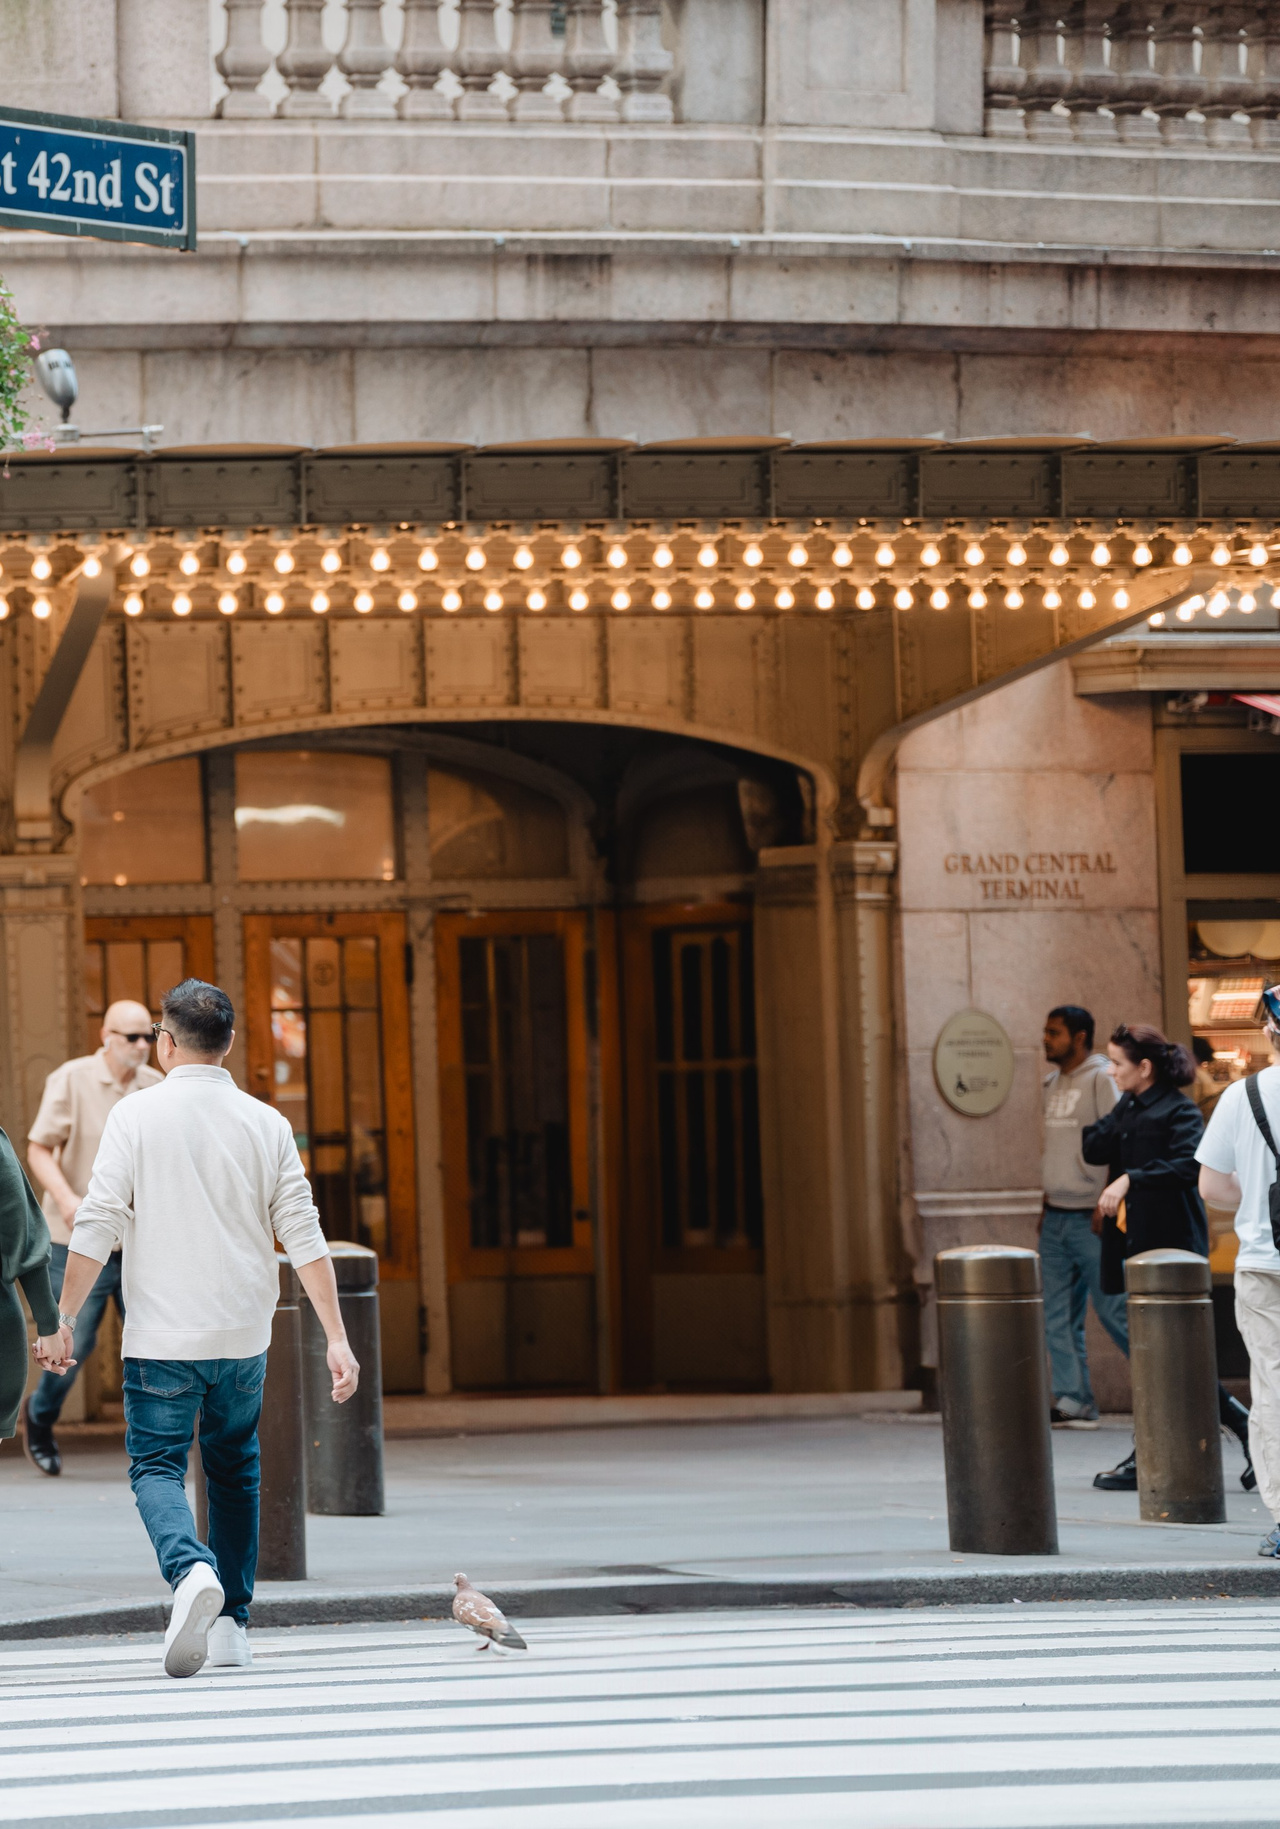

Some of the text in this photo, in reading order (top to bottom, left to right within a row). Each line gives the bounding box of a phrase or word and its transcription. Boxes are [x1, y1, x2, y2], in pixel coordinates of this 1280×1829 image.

[27, 149, 123, 209] 42nd
[134, 162, 176, 217] St
[943, 852, 1118, 875] GRAND CENTRAL
[979, 878, 1085, 900] TERMINAL
